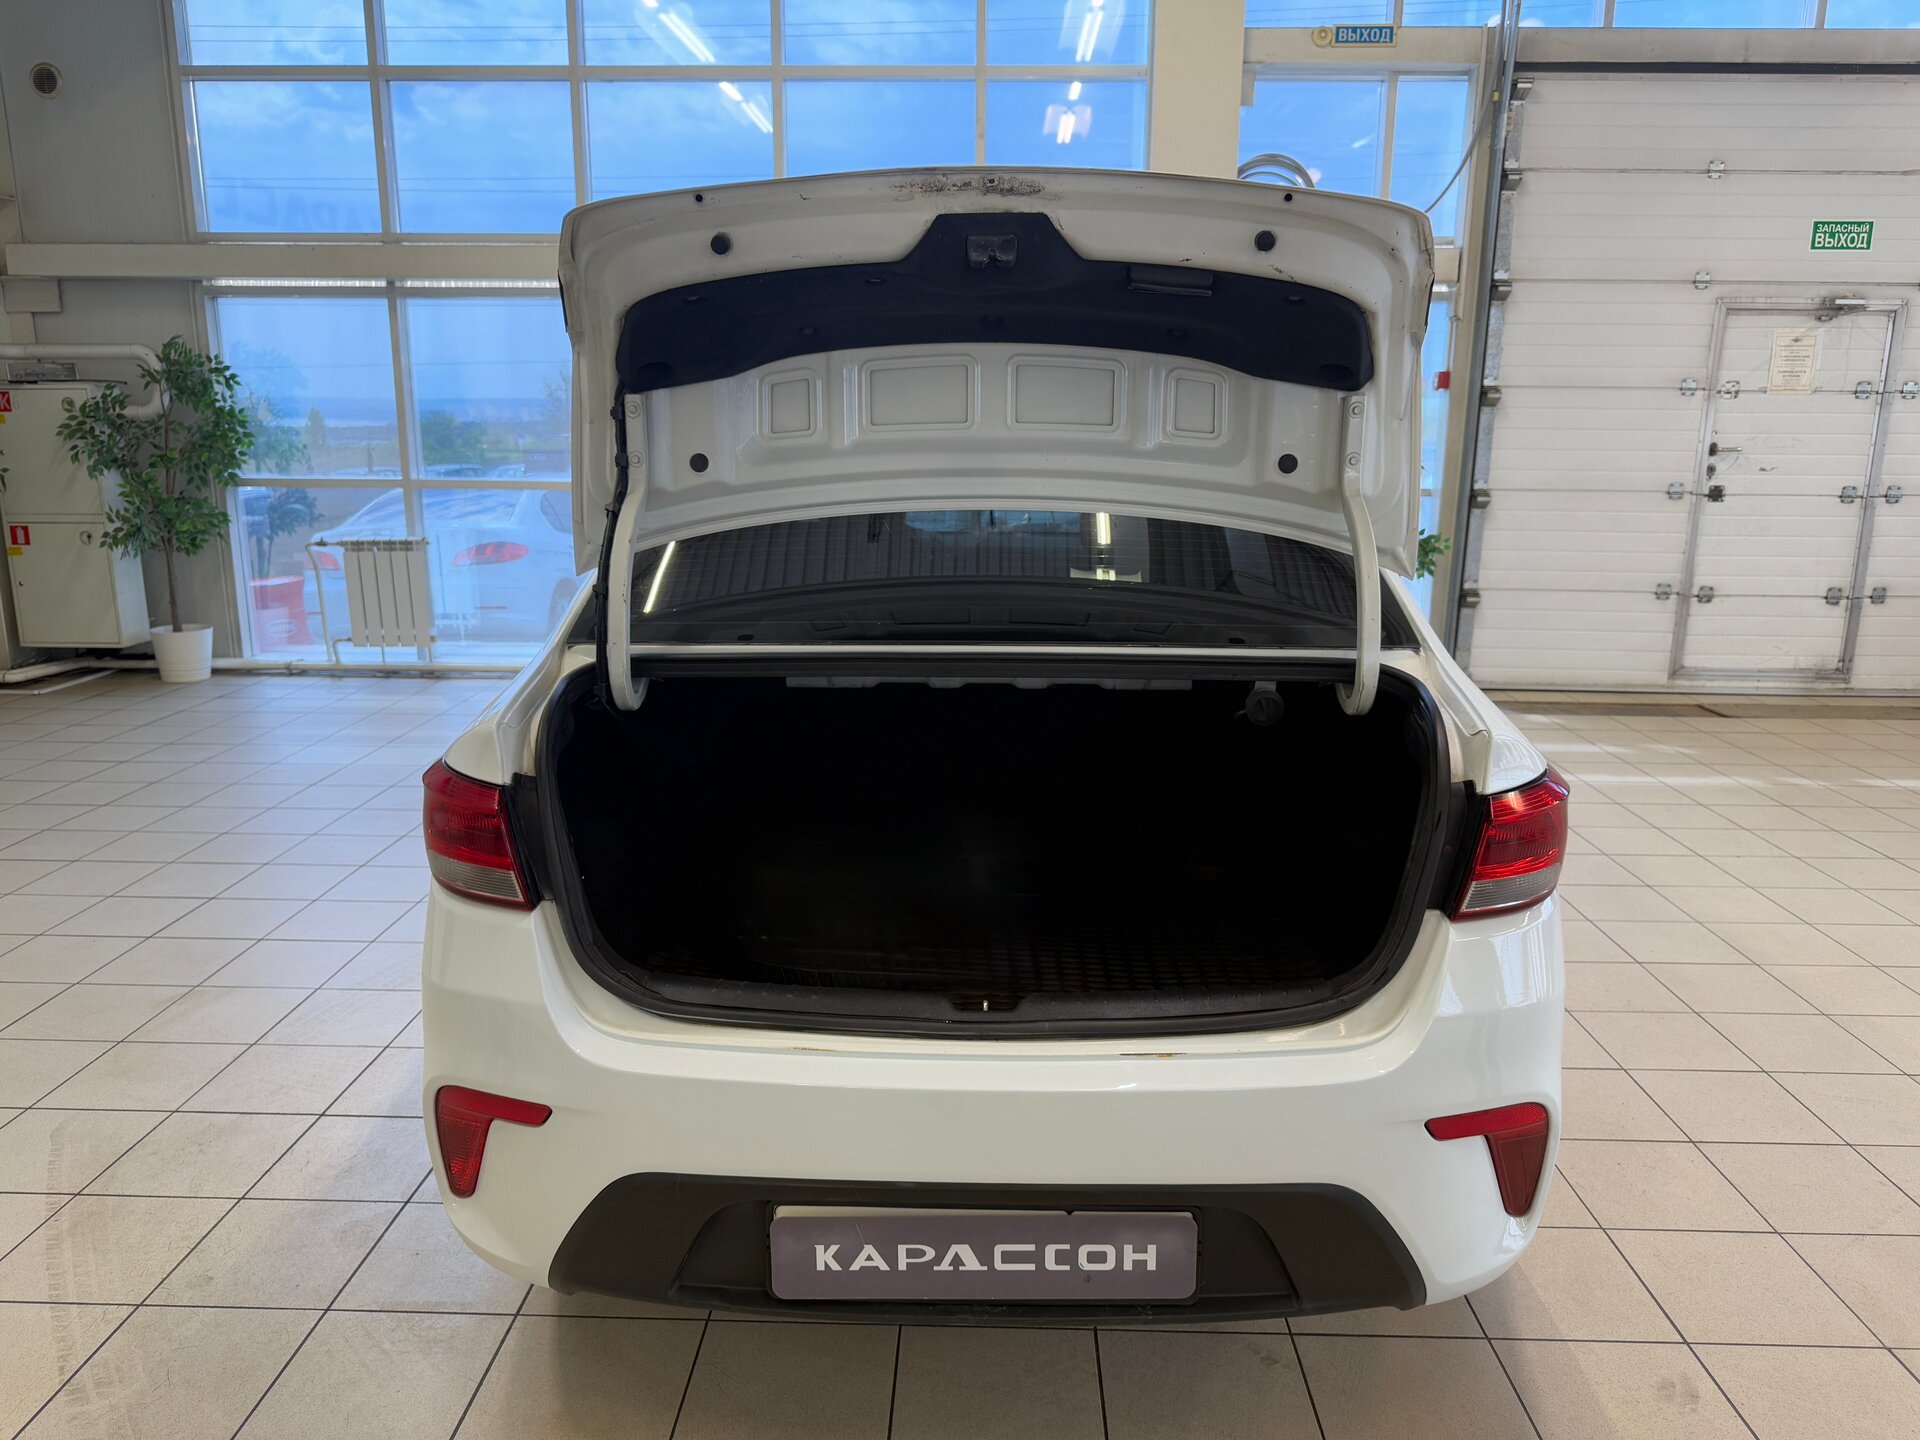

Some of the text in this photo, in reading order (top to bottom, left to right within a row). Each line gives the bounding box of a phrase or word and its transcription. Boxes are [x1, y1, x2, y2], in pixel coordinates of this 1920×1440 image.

[1338, 28, 1391, 42] ВЫХОД
[1816, 222, 1870, 233] ЗАПАСНЫЙ
[1814, 233, 1868, 249] ВЫХОД
[814, 1243, 1157, 1271] КАРАССОН
